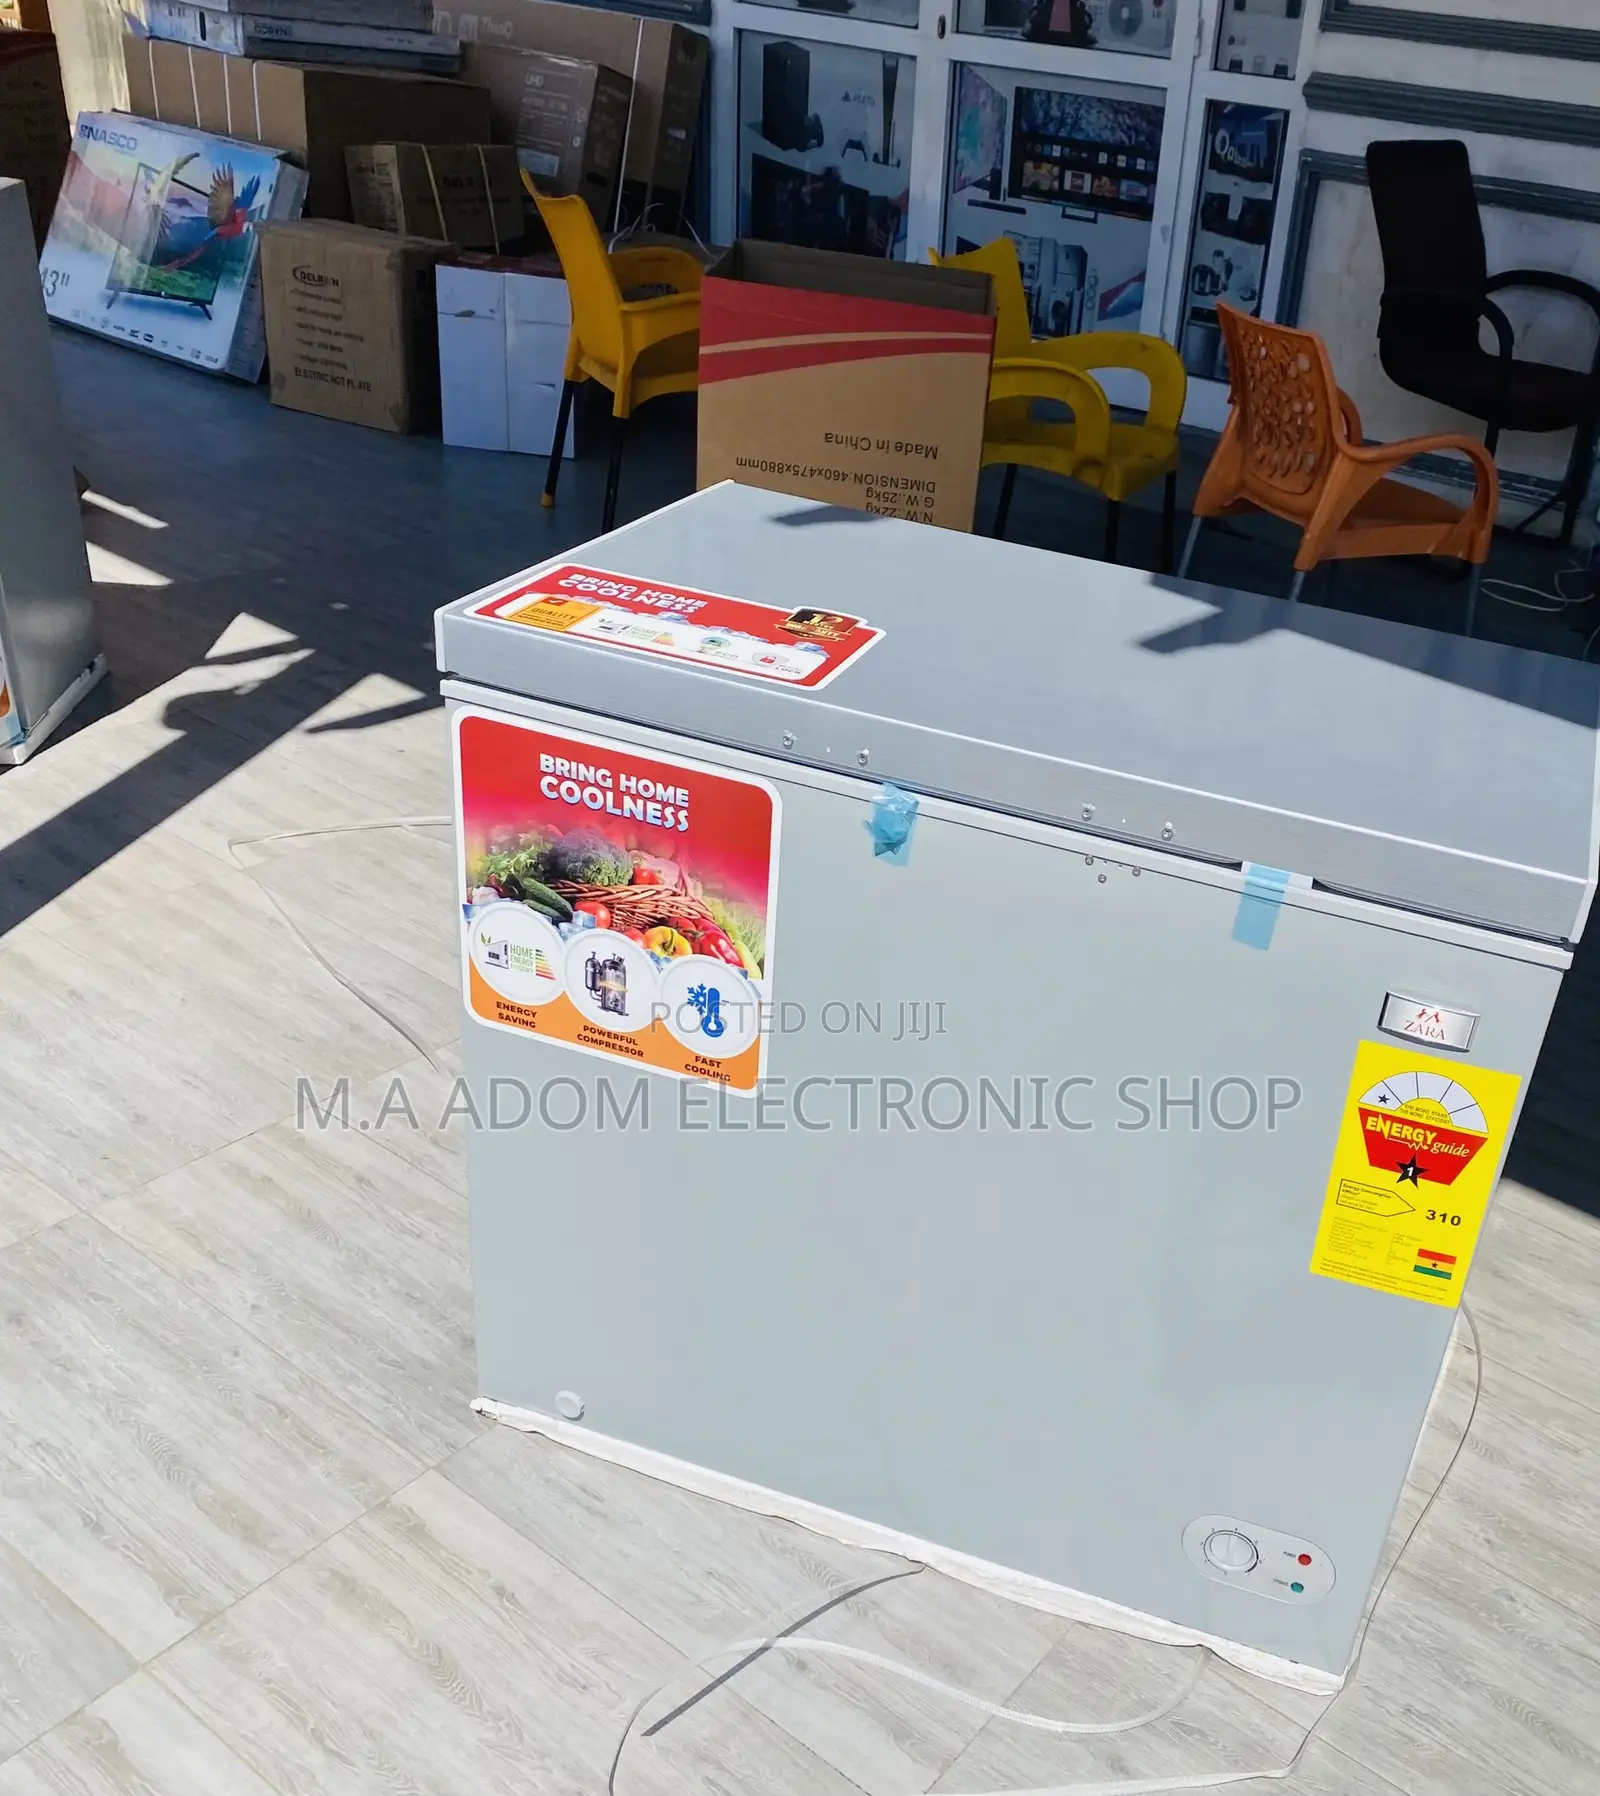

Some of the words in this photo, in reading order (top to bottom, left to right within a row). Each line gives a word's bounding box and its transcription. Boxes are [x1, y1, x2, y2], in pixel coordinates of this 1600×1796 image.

[525, 72, 544, 87] UHD
[87, 126, 138, 151] NASCO
[330, 375, 345, 387] HOT
[824, 432, 871, 451] China
[876, 439, 889, 454] in
[895, 441, 938, 459] Made
[558, 579, 699, 614] COOLNESS
[568, 574, 638, 593] BRING
[643, 589, 708, 608] HOME
[531, 607, 578, 620] QUALITY
[810, 613, 844, 625] 12
[540, 753, 612, 789] BRING
[619, 773, 689, 808] HOME
[539, 776, 689, 832] COOLNESS
[510, 943, 534, 960] HOME
[496, 1001, 538, 1018] ENERGY
[497, 1011, 536, 1029] SAVING
[583, 1024, 639, 1046] POWERFUL
[1403, 1019, 1446, 1041] ZARA
[577, 1033, 644, 1058] COMPRESSOR
[694, 1055, 722, 1069] FAST
[684, 1063, 731, 1082] COOLING
[1431, 1111, 1448, 1119] STARS
[1365, 1114, 1438, 1146] ENERGY
[1431, 1141, 1470, 1158] guide
[1406, 1165, 1415, 1177] 1
[1425, 1209, 1462, 1227] 310
